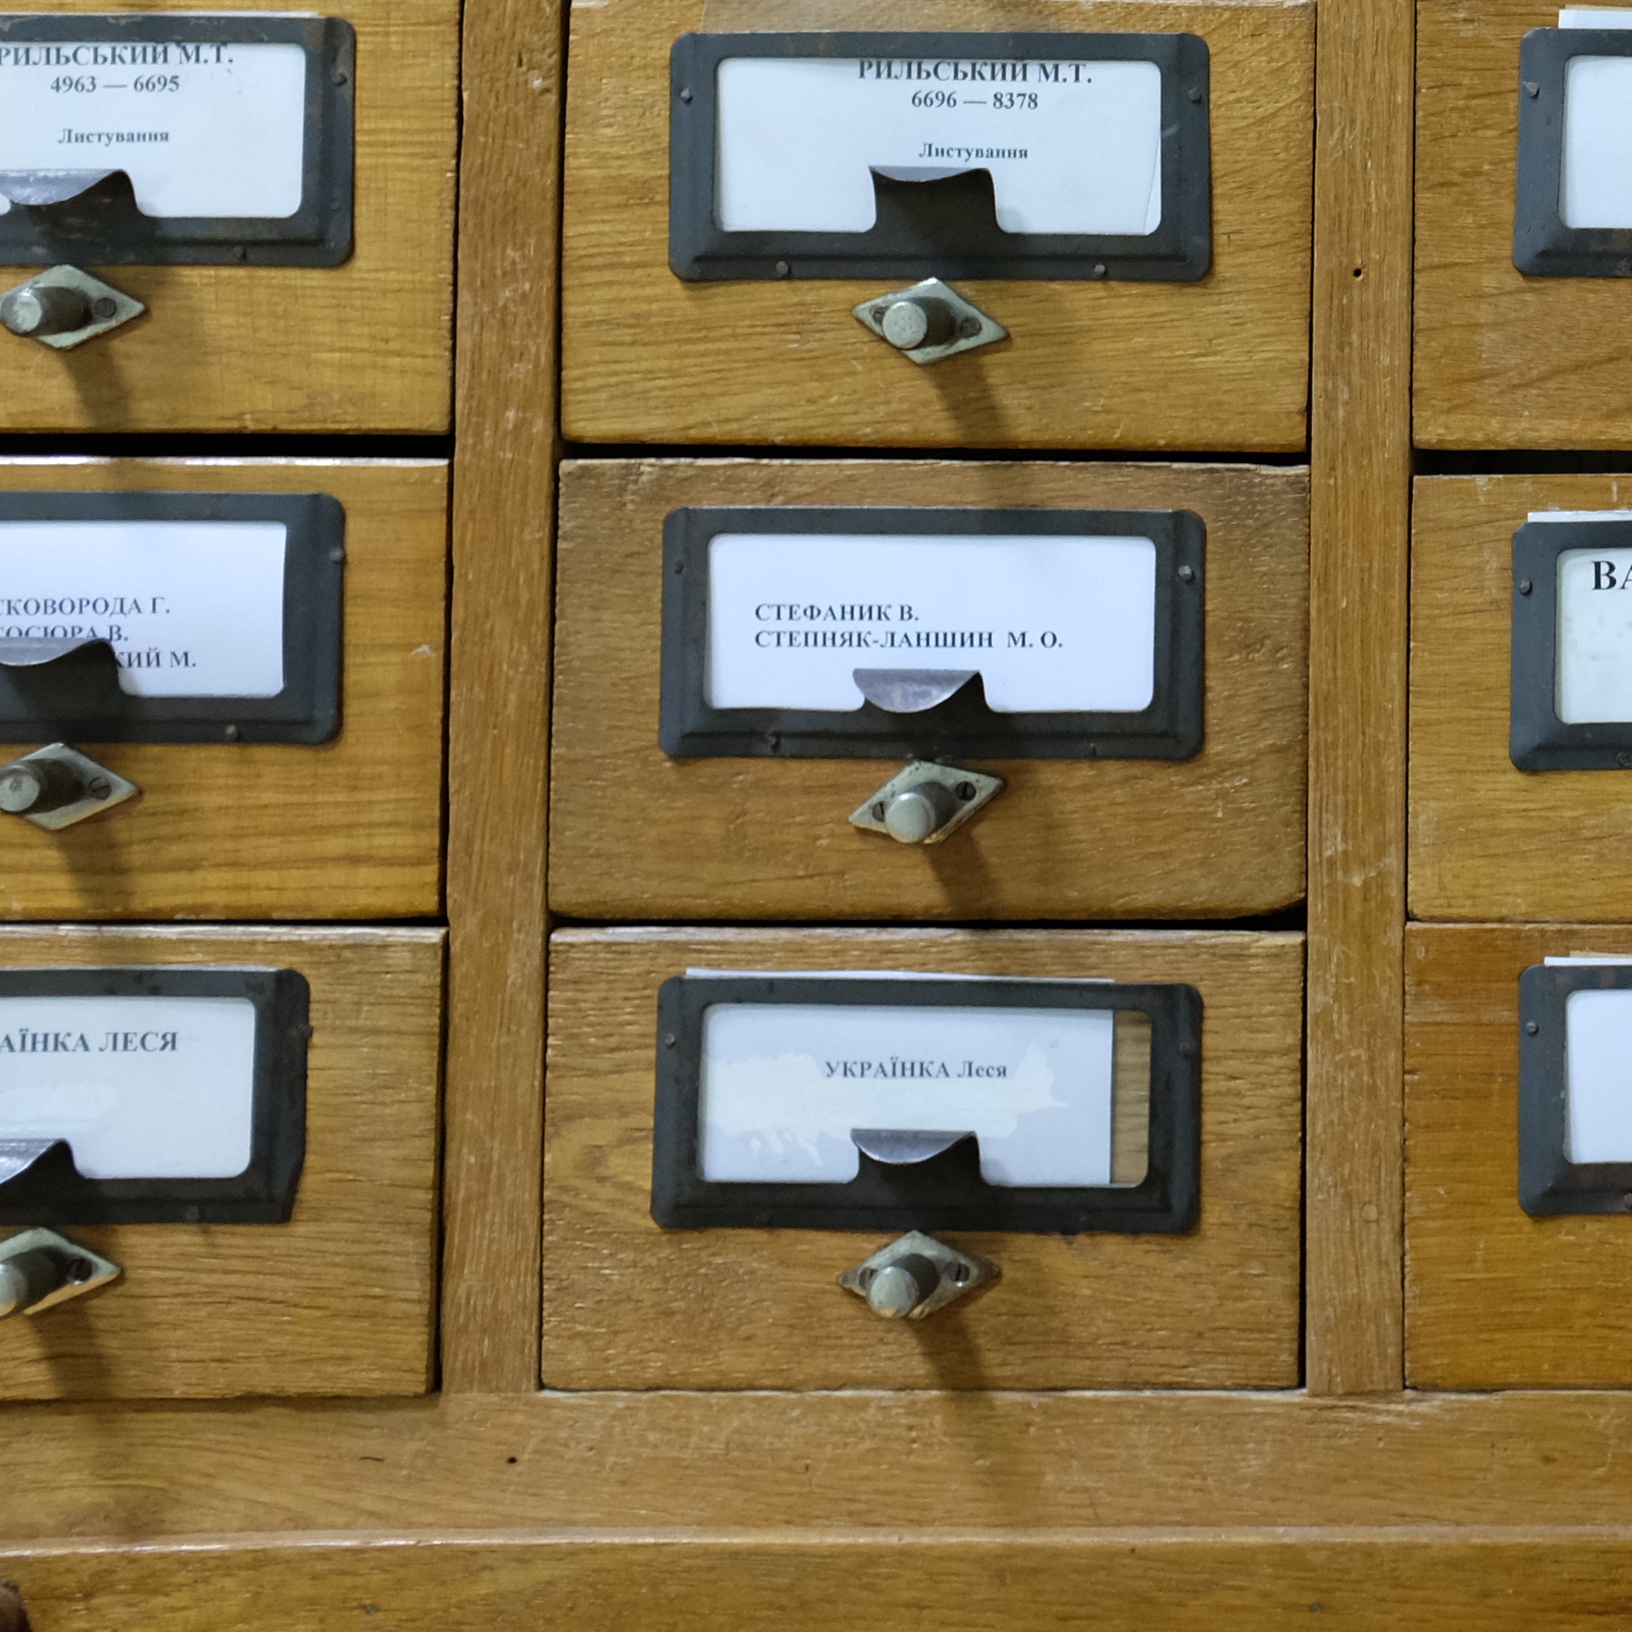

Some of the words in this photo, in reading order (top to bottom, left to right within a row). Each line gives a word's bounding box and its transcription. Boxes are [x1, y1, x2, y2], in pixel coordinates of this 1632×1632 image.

[1037, 63, 1093, 84] М.Т.
[50, 75, 97, 93] 4963
[133, 74, 180, 93] 6695
[911, 90, 957, 108] 6696
[992, 91, 1039, 110] 8378
[57, 128, 170, 147] Листування
[918, 142, 1028, 163] Листування
[151, 597, 170, 614] Г.
[754, 604, 892, 622] СТЕФАНИК
[899, 604, 919, 622] В.
[754, 630, 993, 648] СТЕПНЯК-ЛАНШИН
[1007, 631, 1033, 648] М.
[1040, 631, 1063, 648] О.
[170, 650, 197, 668] М.
[98, 1031, 178, 1052] ЛЕСЯ
[825, 1056, 950, 1079] УКРАЇНКА
[956, 1060, 1007, 1078] Леся
